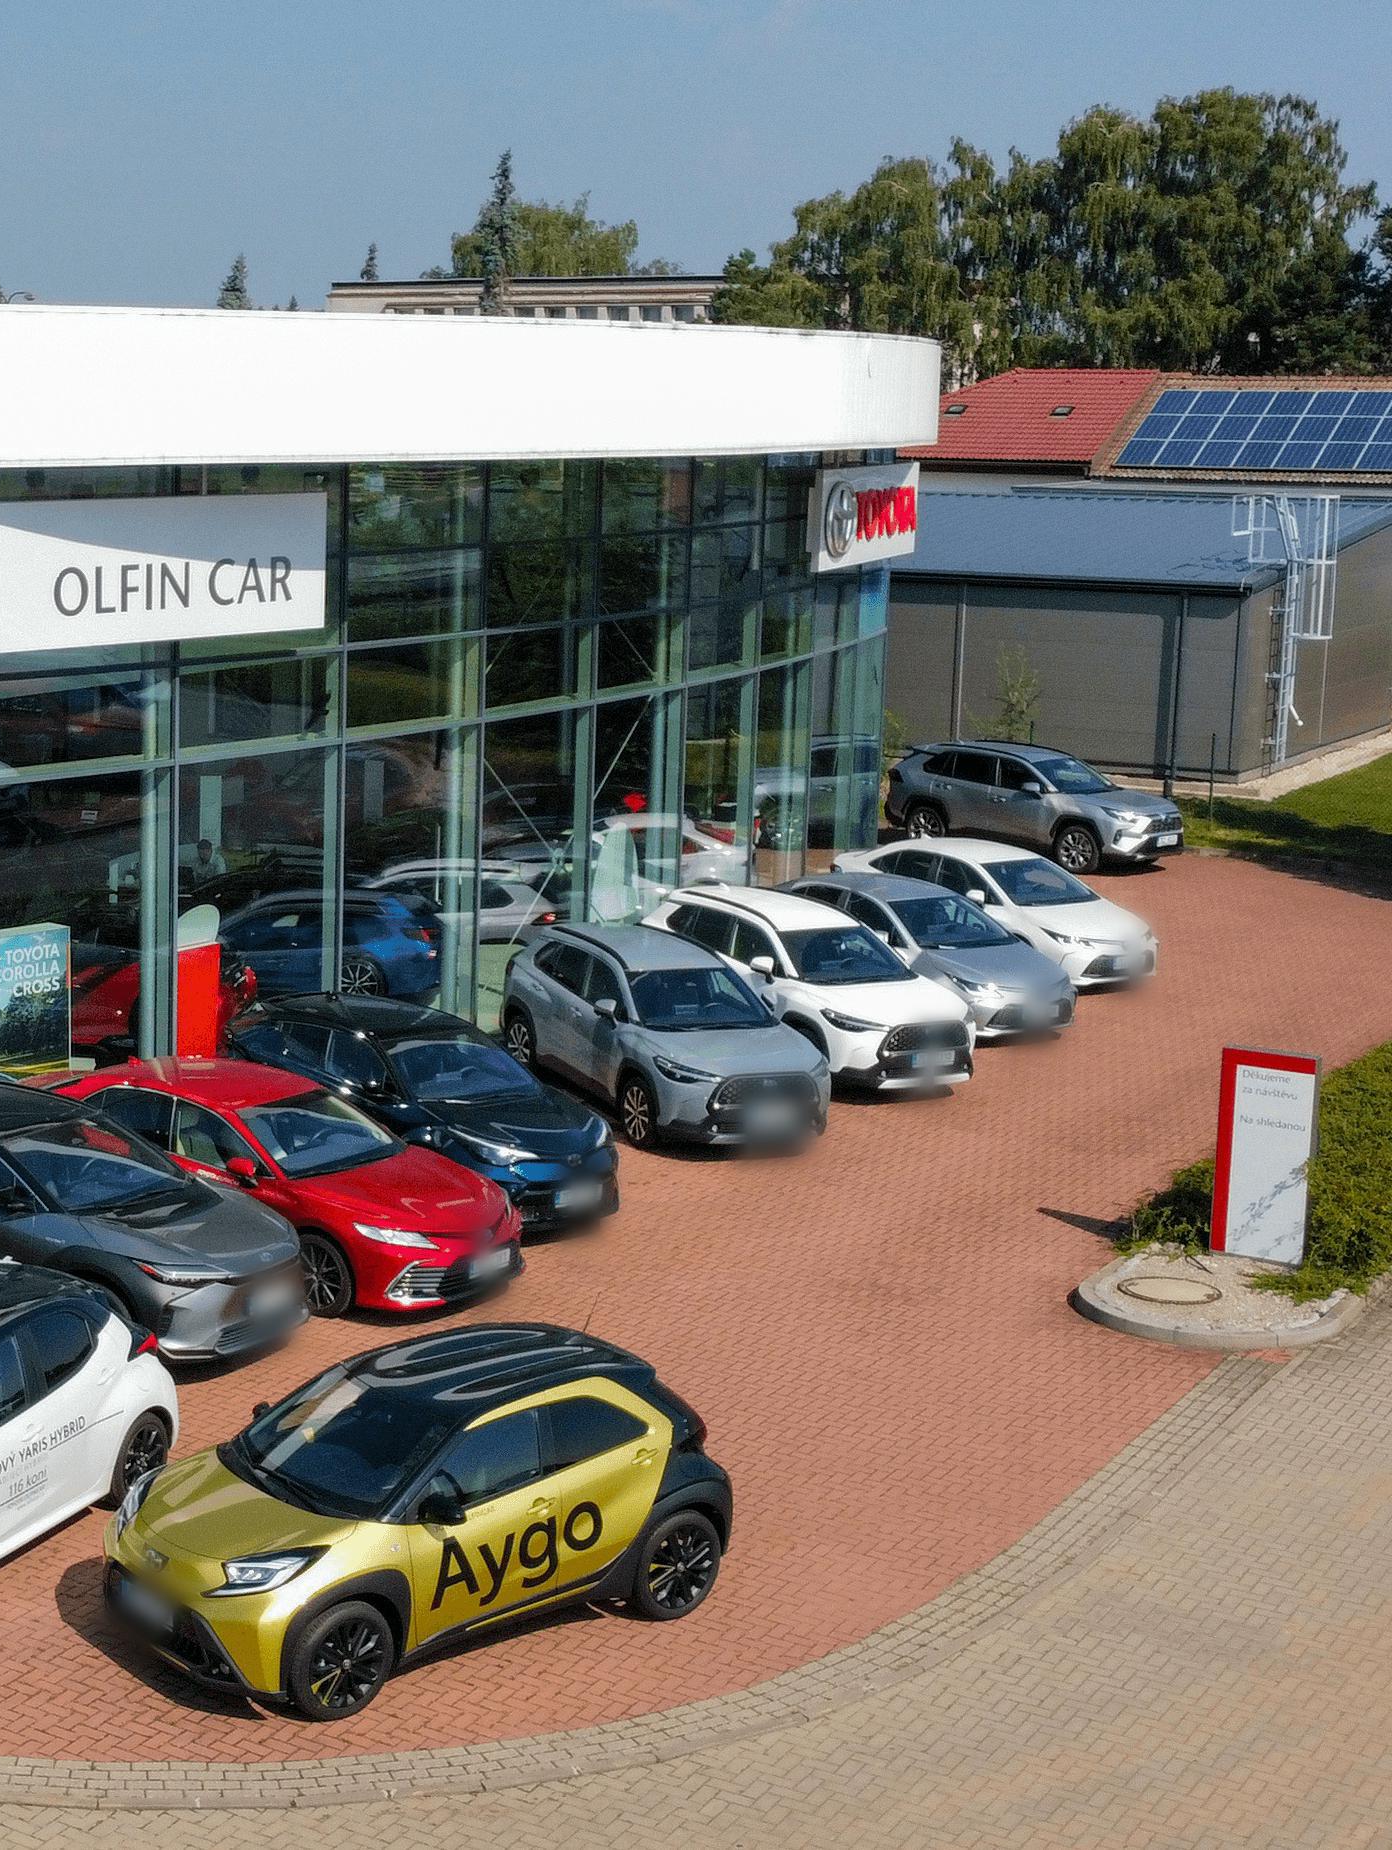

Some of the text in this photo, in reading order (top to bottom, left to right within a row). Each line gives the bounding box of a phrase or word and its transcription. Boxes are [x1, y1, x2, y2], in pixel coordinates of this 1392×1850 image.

[53, 555, 293, 617] OLFIN CAR
[5, 943, 60, 965] TOYOTA
[13, 976, 61, 998] CROSS
[1242, 1068, 1291, 1084] Děkujeme
[1242, 1086, 1253, 1095] za
[1240, 1114, 1306, 1132] Na shledanou
[18, 1436, 48, 1463] YARIS
[49, 1416, 86, 1446] HYBRID
[9, 1479, 24, 1497] 116
[431, 1501, 603, 1612] Aygo
